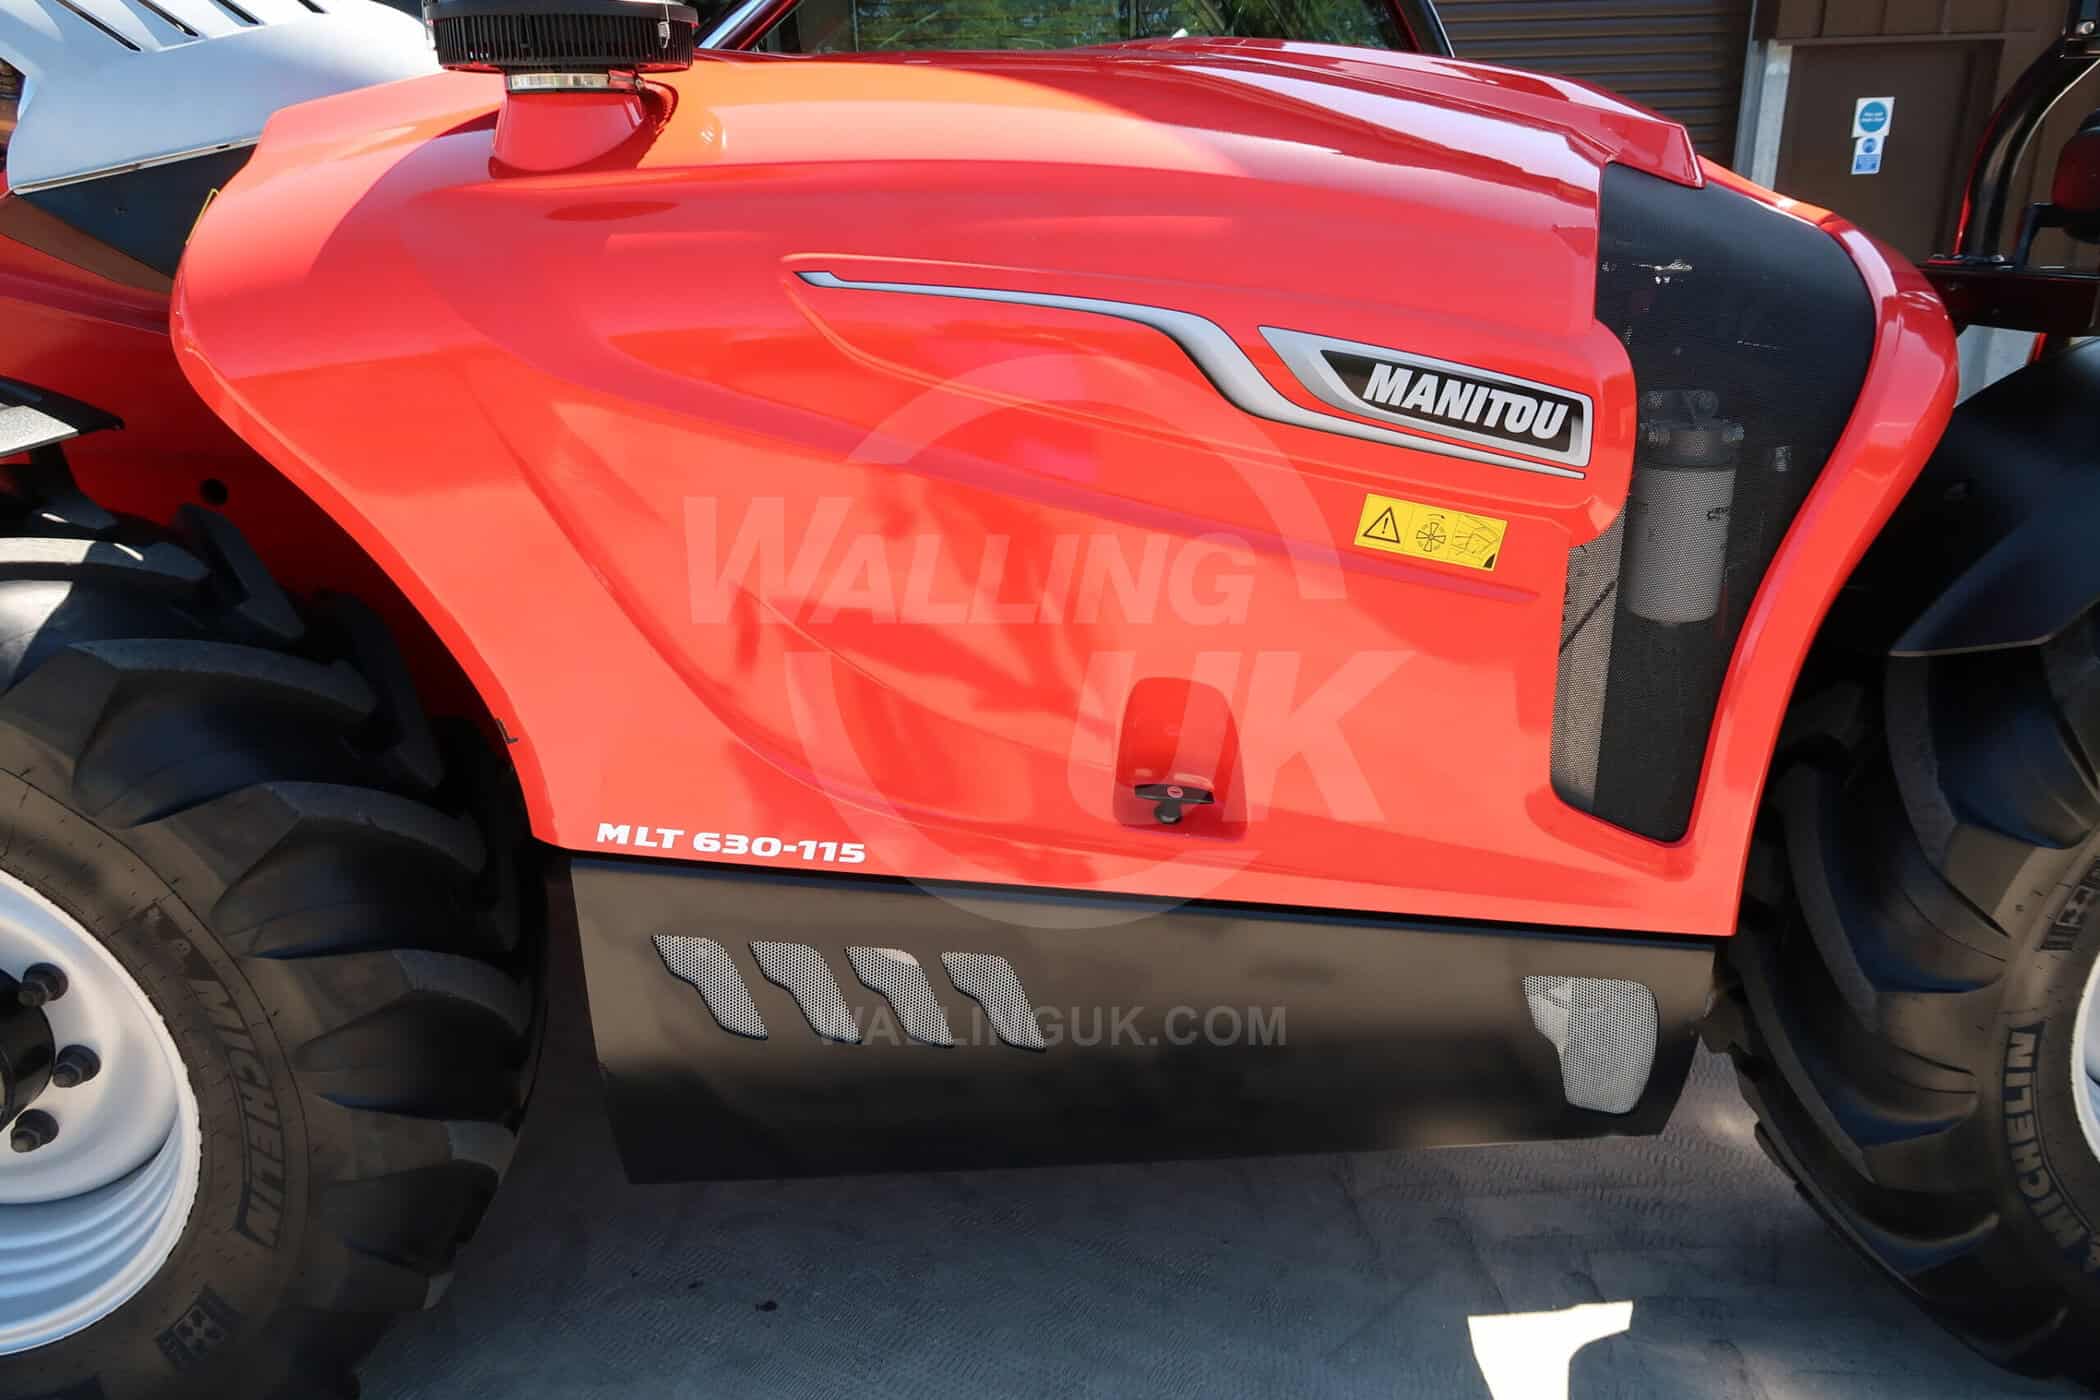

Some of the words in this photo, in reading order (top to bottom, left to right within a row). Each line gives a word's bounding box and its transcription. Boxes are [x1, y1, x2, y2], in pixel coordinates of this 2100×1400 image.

[1362, 363, 1569, 440] MANITOU
[595, 822, 685, 850] MLT
[692, 831, 867, 864] 630-115
[2004, 1028, 2086, 1252] MICHELIN
